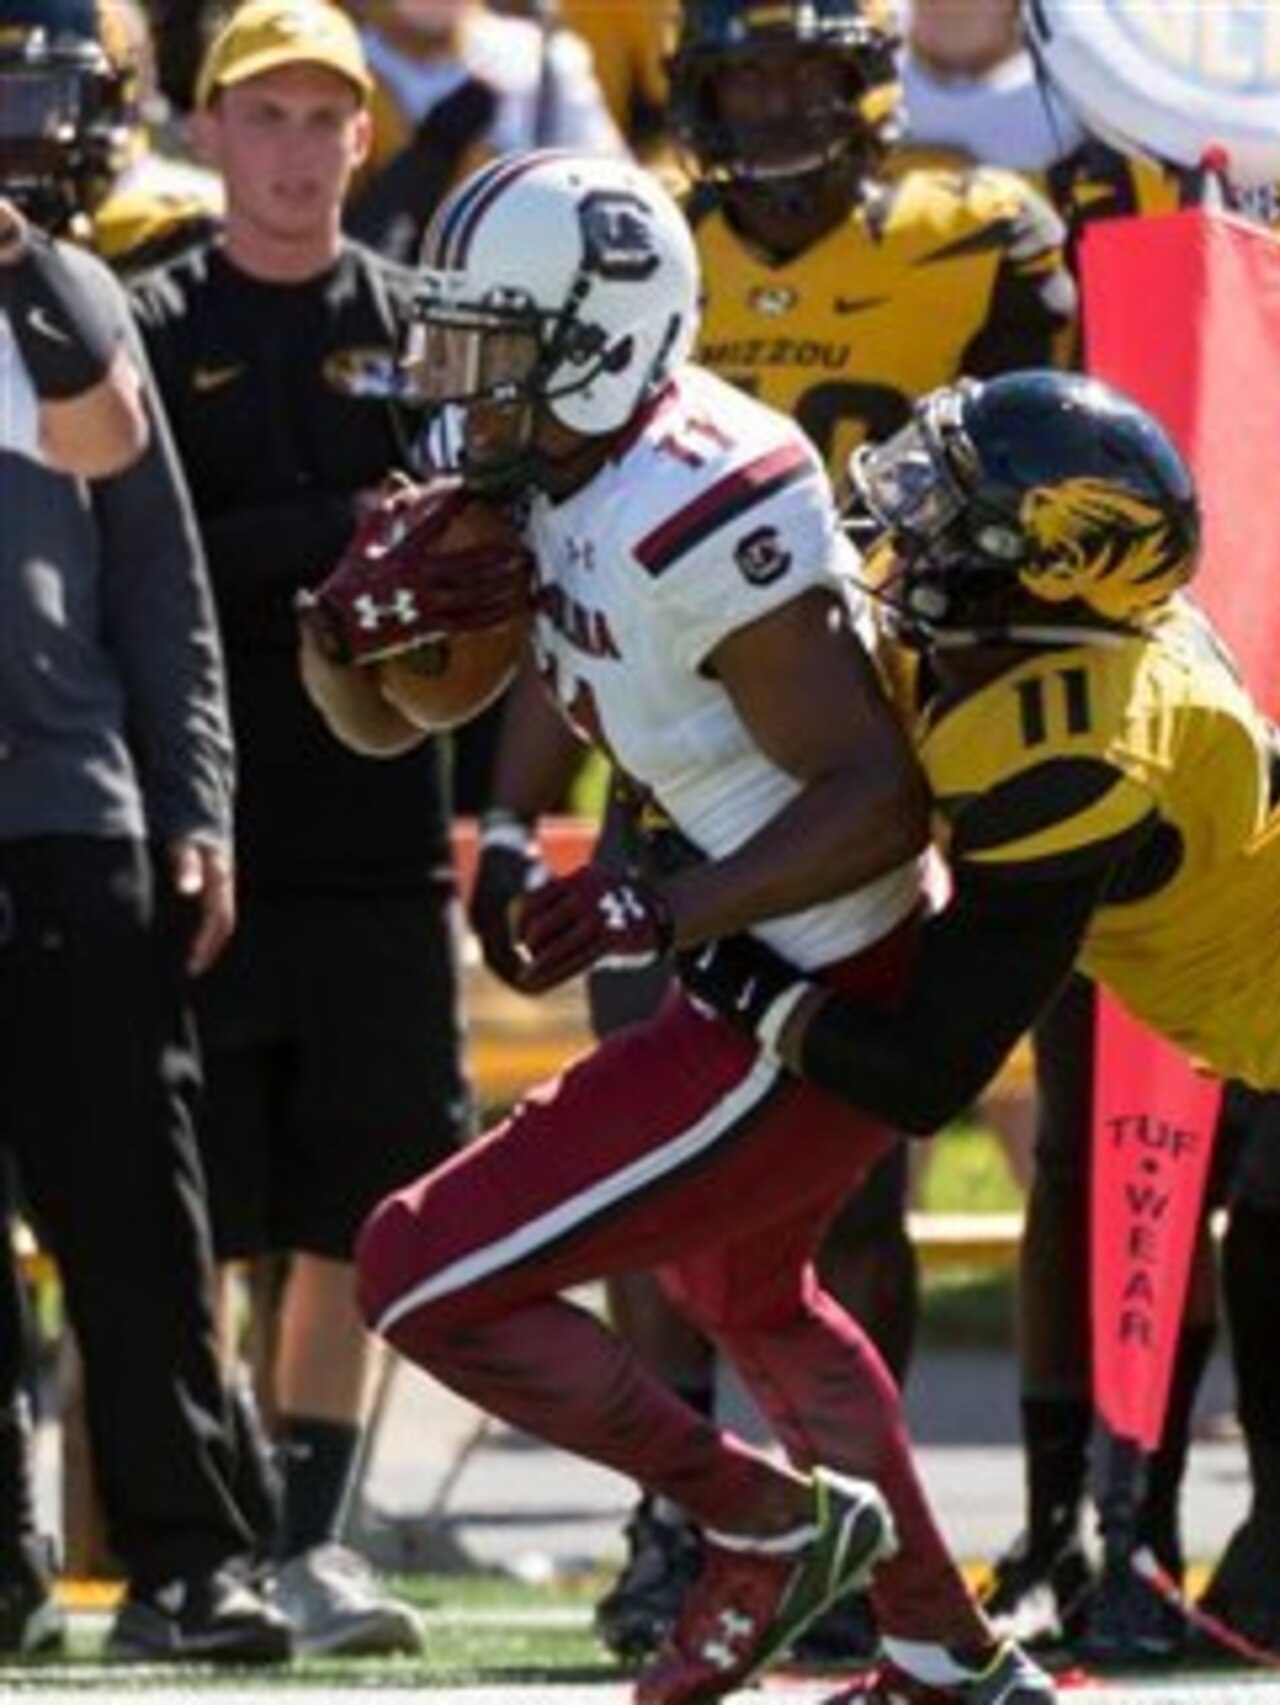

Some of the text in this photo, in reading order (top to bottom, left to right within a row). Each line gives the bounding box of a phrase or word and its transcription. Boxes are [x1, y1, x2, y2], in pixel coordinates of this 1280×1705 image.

[702, 338, 850, 370] MIZZOU
[1014, 667, 1091, 749] 11
[1104, 1114, 1198, 1161] TUF
[1119, 1182, 1170, 1346] WEAR
